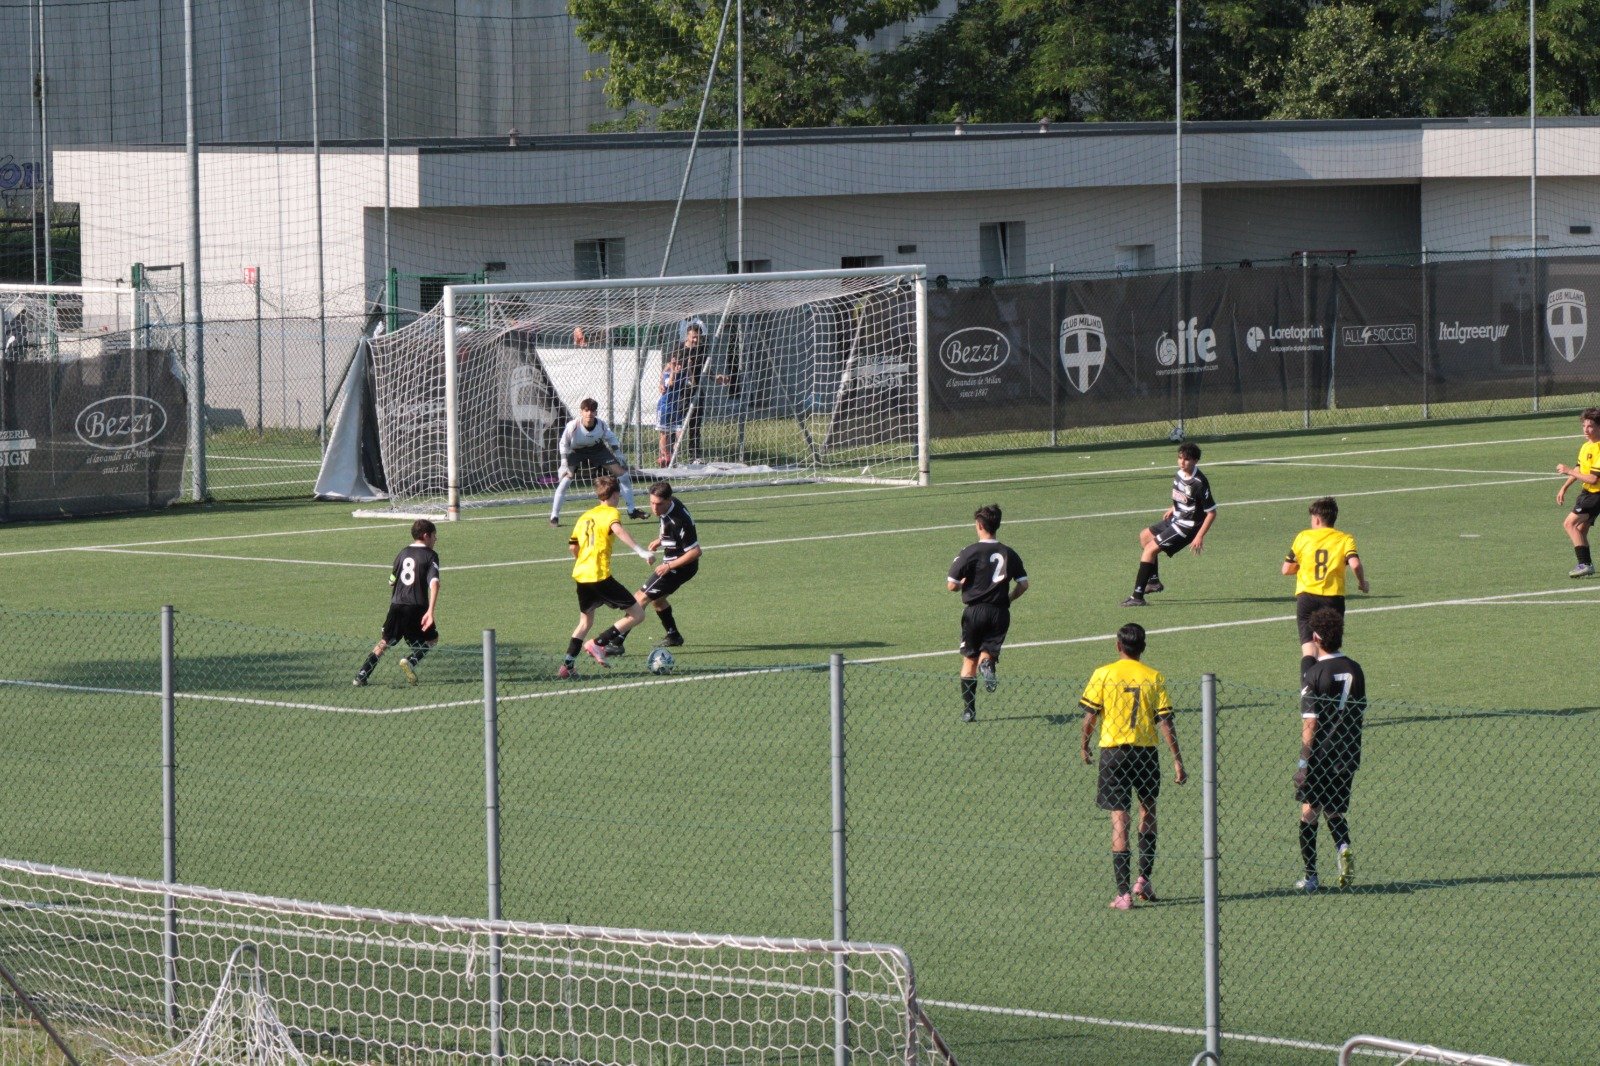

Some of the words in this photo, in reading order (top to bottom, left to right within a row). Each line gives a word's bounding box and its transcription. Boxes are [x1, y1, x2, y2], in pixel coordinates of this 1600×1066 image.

[1549, 291, 1562, 303] CLUB
[1564, 291, 1583, 303] MILANO
[1063, 318, 1078, 330] CLUB
[1079, 317, 1102, 329] MILANO
[1269, 325, 1324, 342] Loretoprint
[947, 336, 999, 364] Bezzi
[959, 388, 974, 398] since
[85, 404, 153, 438] Bezzi
[102, 465, 119, 475] since
[119, 462, 138, 473] 1887
[585, 518, 596, 547] 11
[401, 557, 415, 585] 8
[990, 553, 1004, 583] 2
[1315, 549, 1328, 581] 8
[1333, 673, 1353, 711] 7
[1124, 687, 1140, 729] 7
